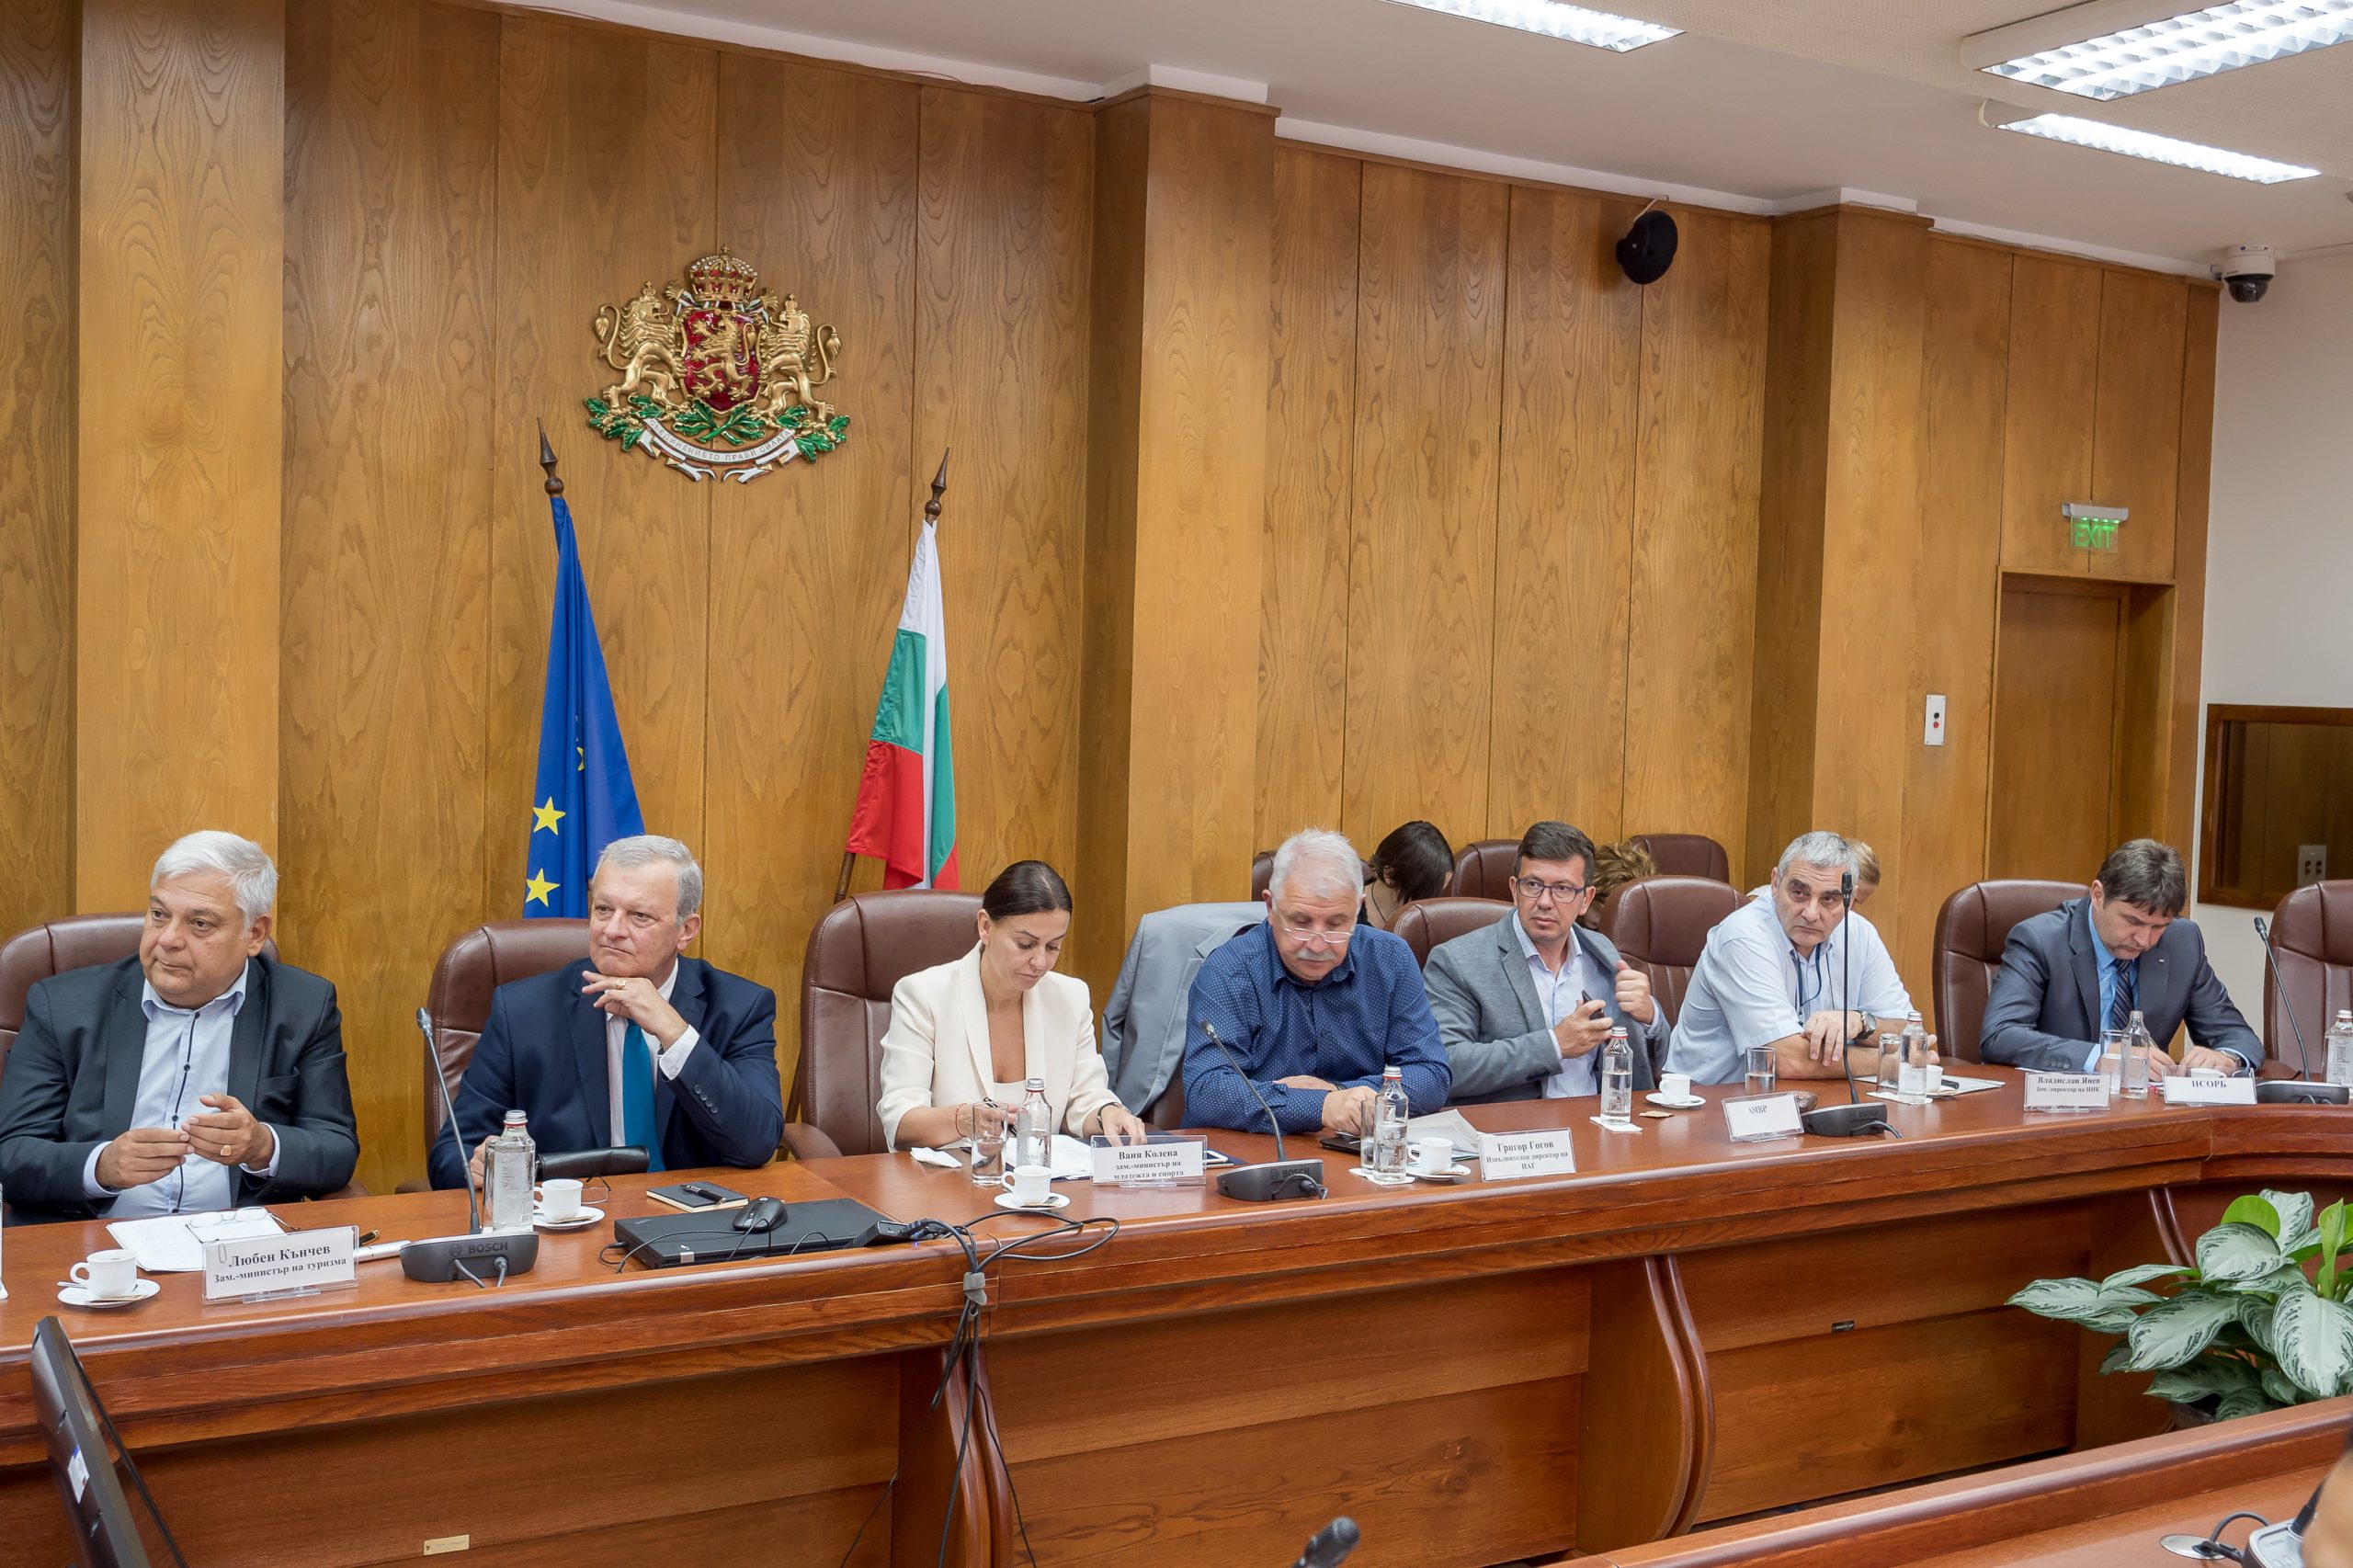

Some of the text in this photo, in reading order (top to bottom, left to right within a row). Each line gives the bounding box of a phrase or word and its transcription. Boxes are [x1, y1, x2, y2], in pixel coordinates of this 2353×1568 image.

[649, 419, 791, 461] СЪЕДИНЕНИЕТО ПРАВИ СИЛАТА
[2074, 524, 2114, 549] EXIT
[1119, 1150, 1177, 1160] Ваня Колева
[1497, 1141, 1554, 1153] Григор Гогов
[1282, 1167, 1310, 1177] BOSCH
[229, 1245, 331, 1267] Любен Кънчев
[468, 1242, 508, 1255] BOSCH
[213, 1267, 290, 1283] Зам.-министър
[307, 1259, 347, 1272] туризма
